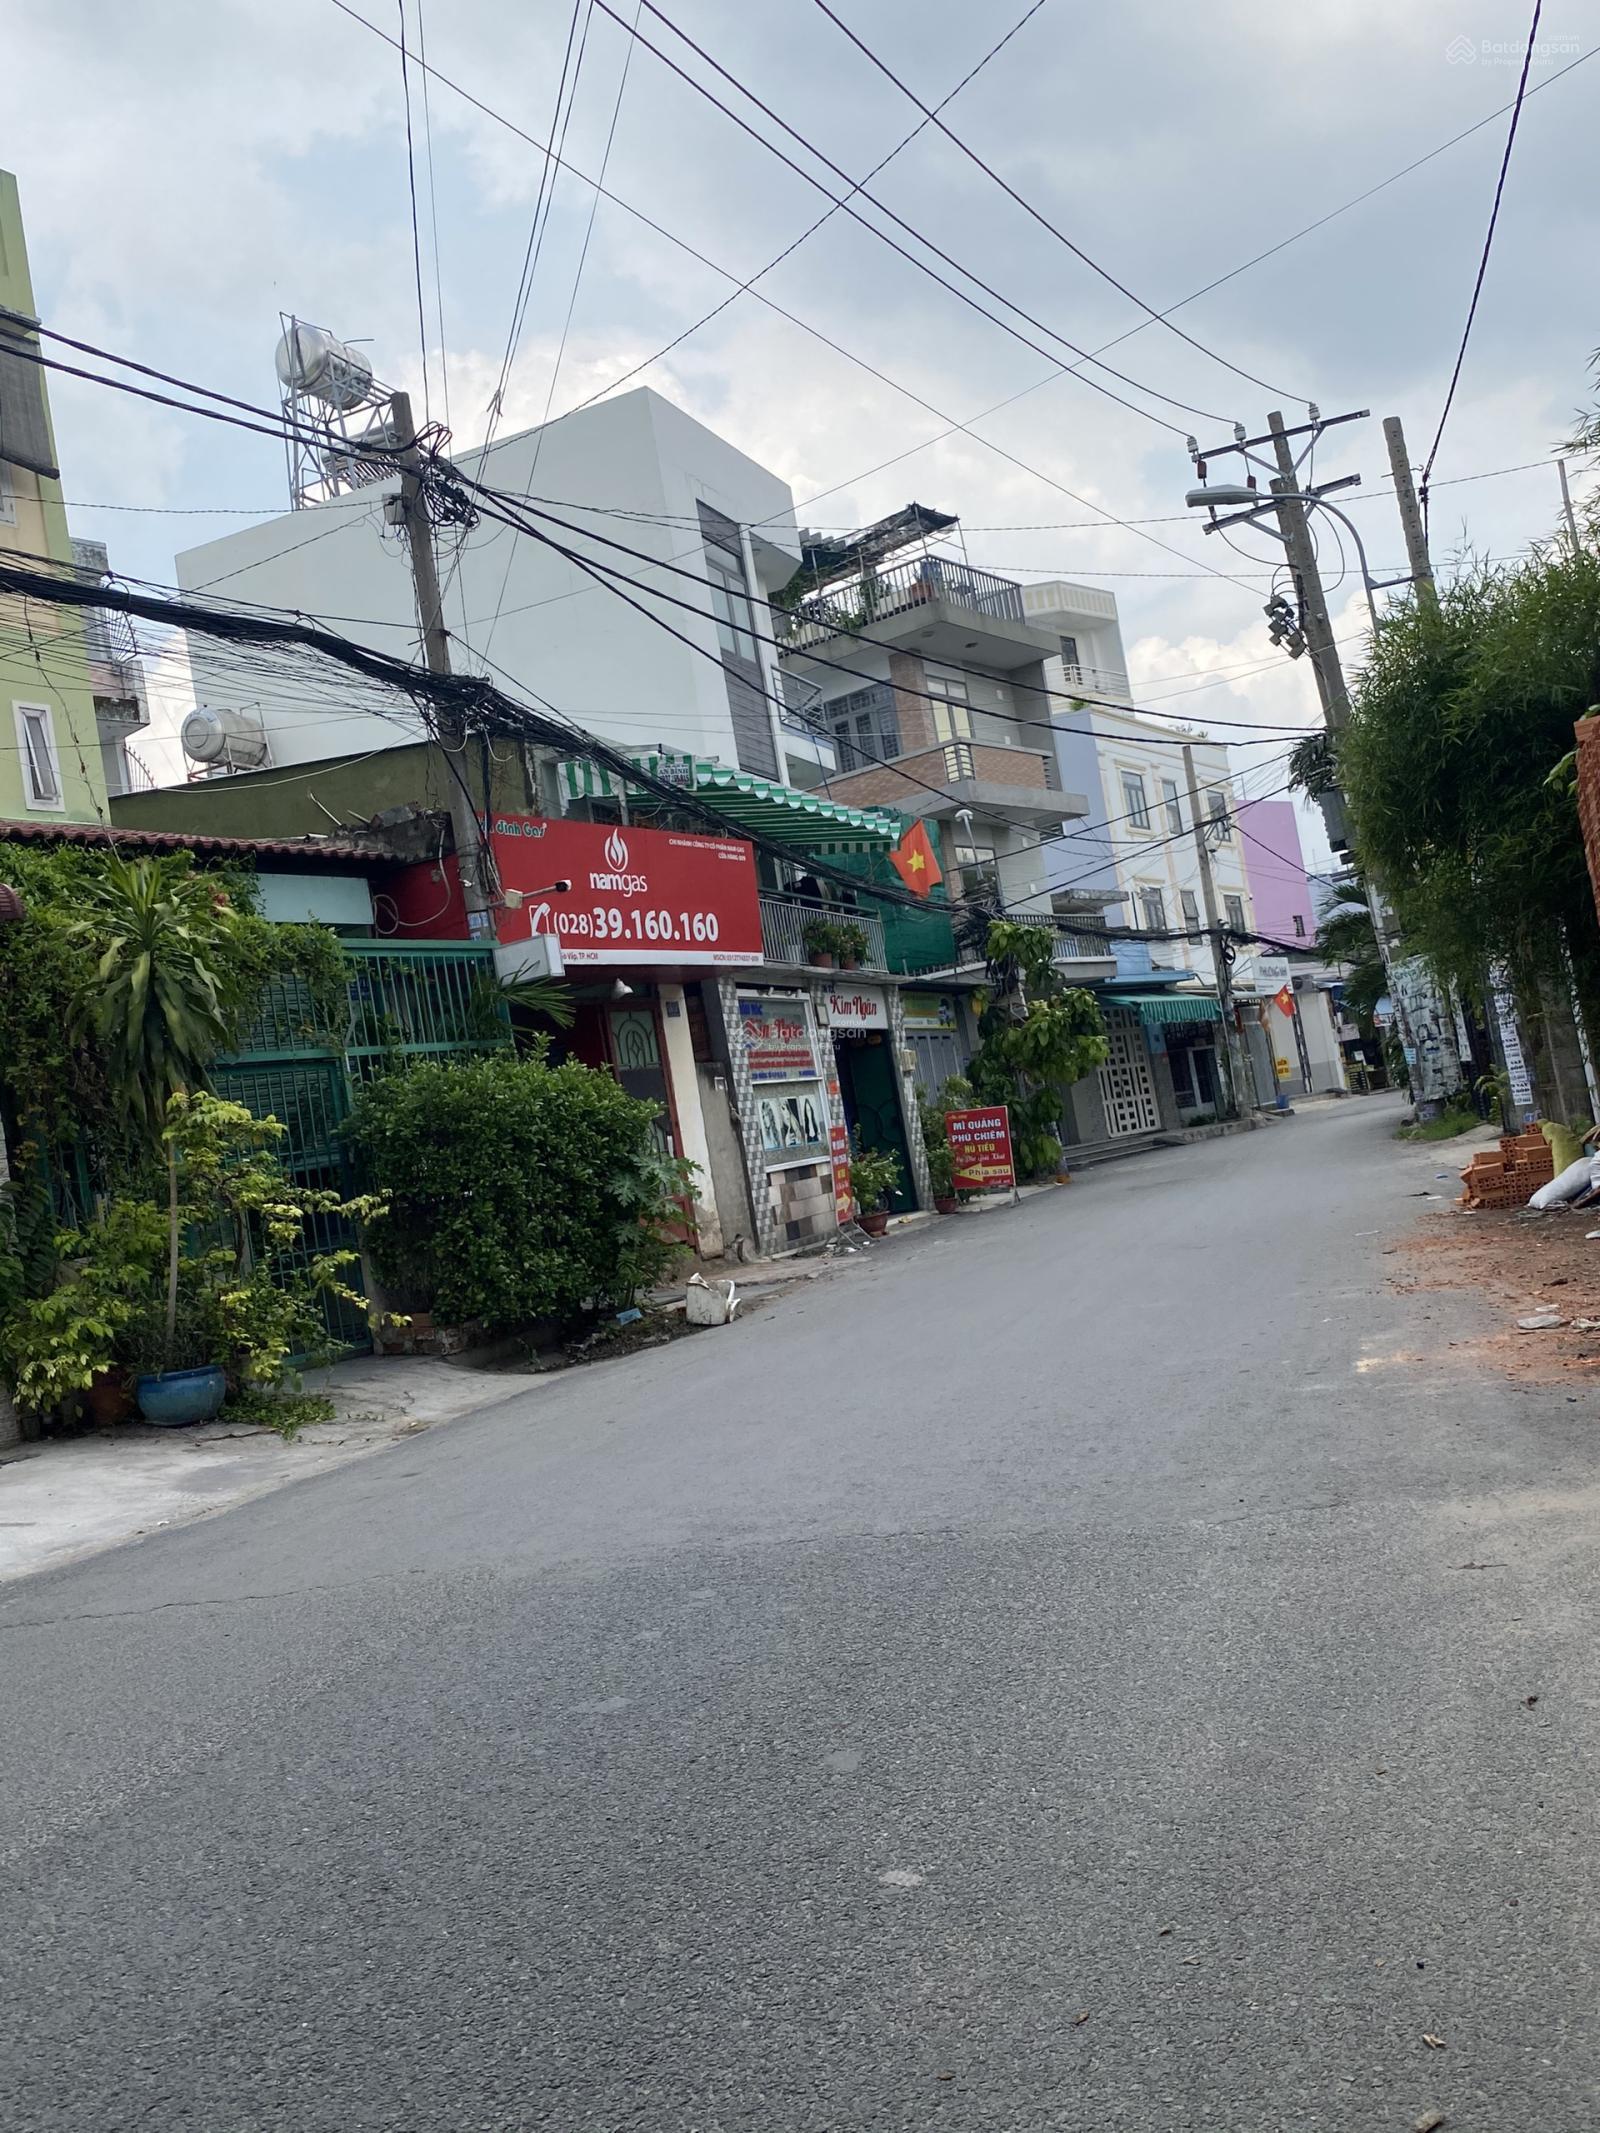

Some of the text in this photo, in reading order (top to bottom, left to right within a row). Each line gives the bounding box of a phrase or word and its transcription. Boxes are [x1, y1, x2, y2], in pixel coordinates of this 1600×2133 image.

[523, 821, 546, 837] Gas
[590, 871, 648, 898] namgas
[830, 994, 877, 1020] Kim Ngân
[953, 1120, 965, 1130] MÌ
[968, 1117, 1001, 1129] QUẢNG
